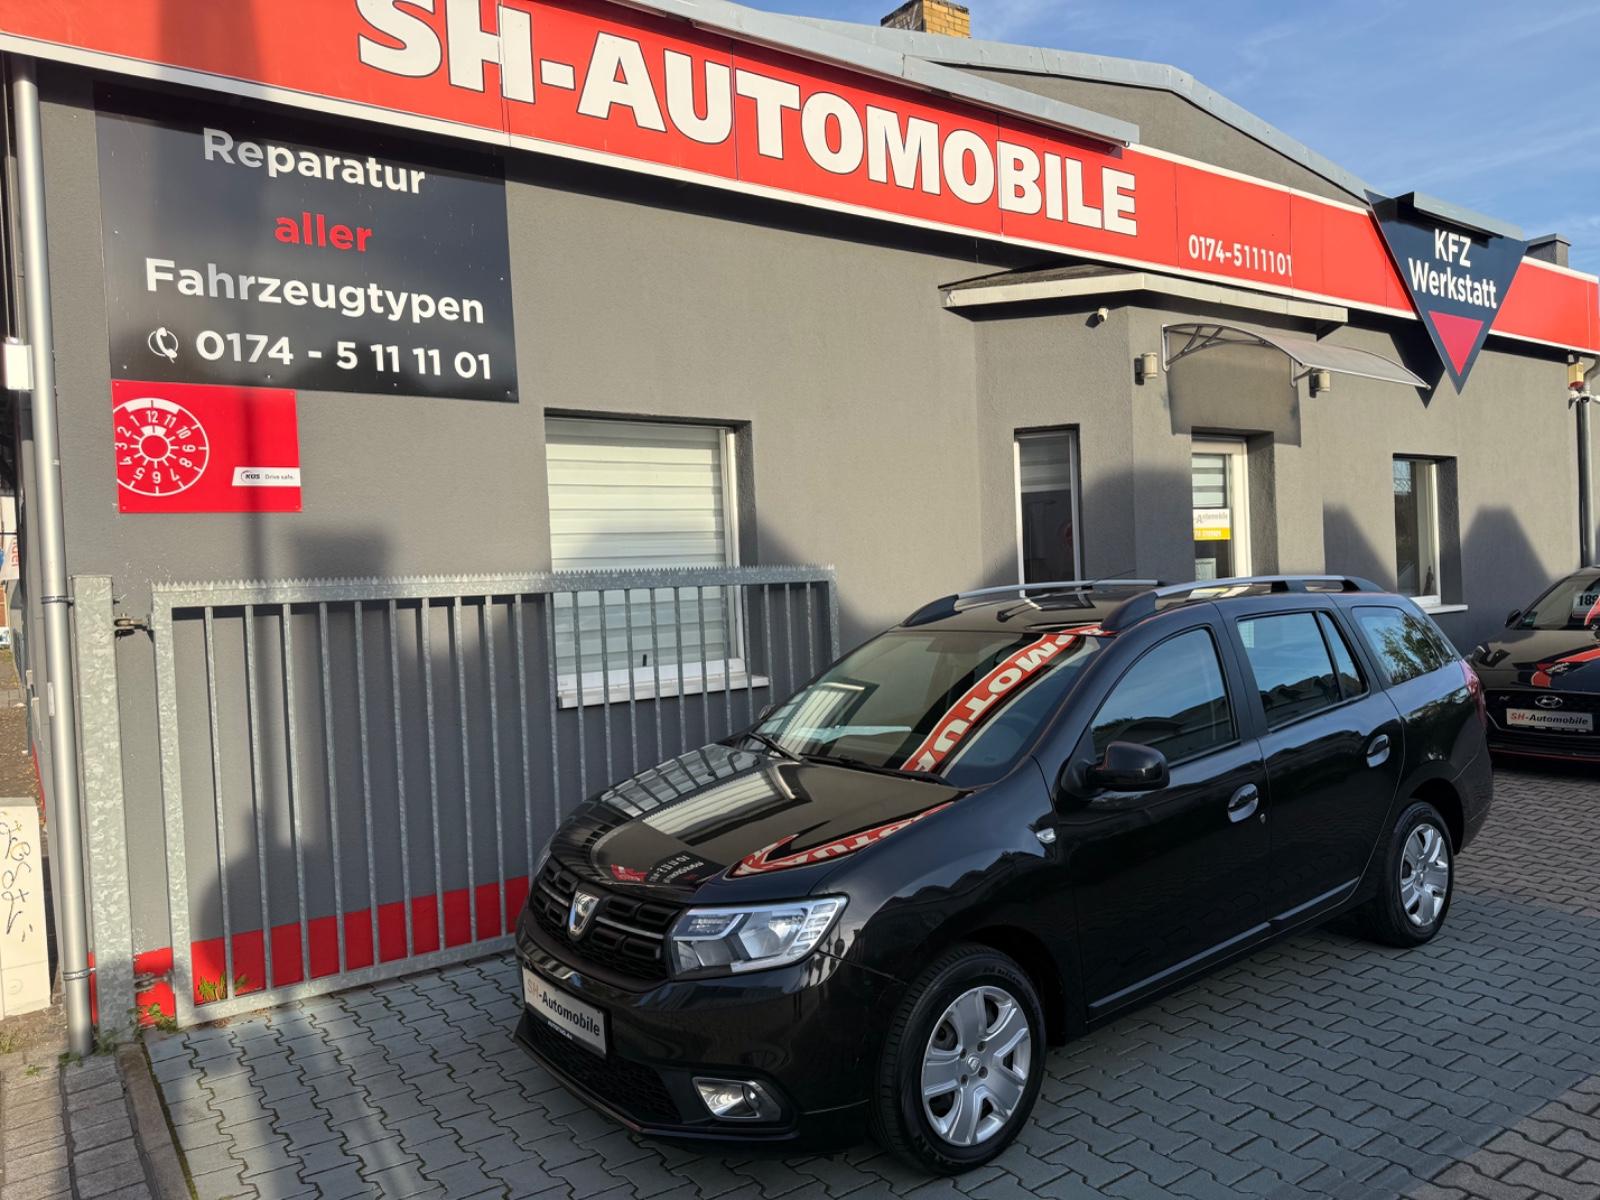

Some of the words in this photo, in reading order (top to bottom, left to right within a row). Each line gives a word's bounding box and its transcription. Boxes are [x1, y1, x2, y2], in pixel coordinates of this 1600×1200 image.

[358, 0, 1138, 237] SH-AUTOMOBILE
[203, 127, 426, 195] Reparatur
[274, 211, 373, 253] aller
[1188, 234, 1293, 278] 0174-5111101
[1434, 228, 1472, 268] KFZ
[145, 257, 485, 325] Fahrzeugtypen
[1407, 257, 1498, 309] Werkstatt
[195, 330, 294, 366] 0174
[336, 341, 358, 371] 5
[370, 343, 400, 373] 11
[412, 347, 442, 376] 11
[454, 352, 491, 380] 01
[146, 410, 159, 424] 12
[1510, 711, 1589, 726] SH-Automobile
[527, 978, 600, 1037] SH-Automobile
